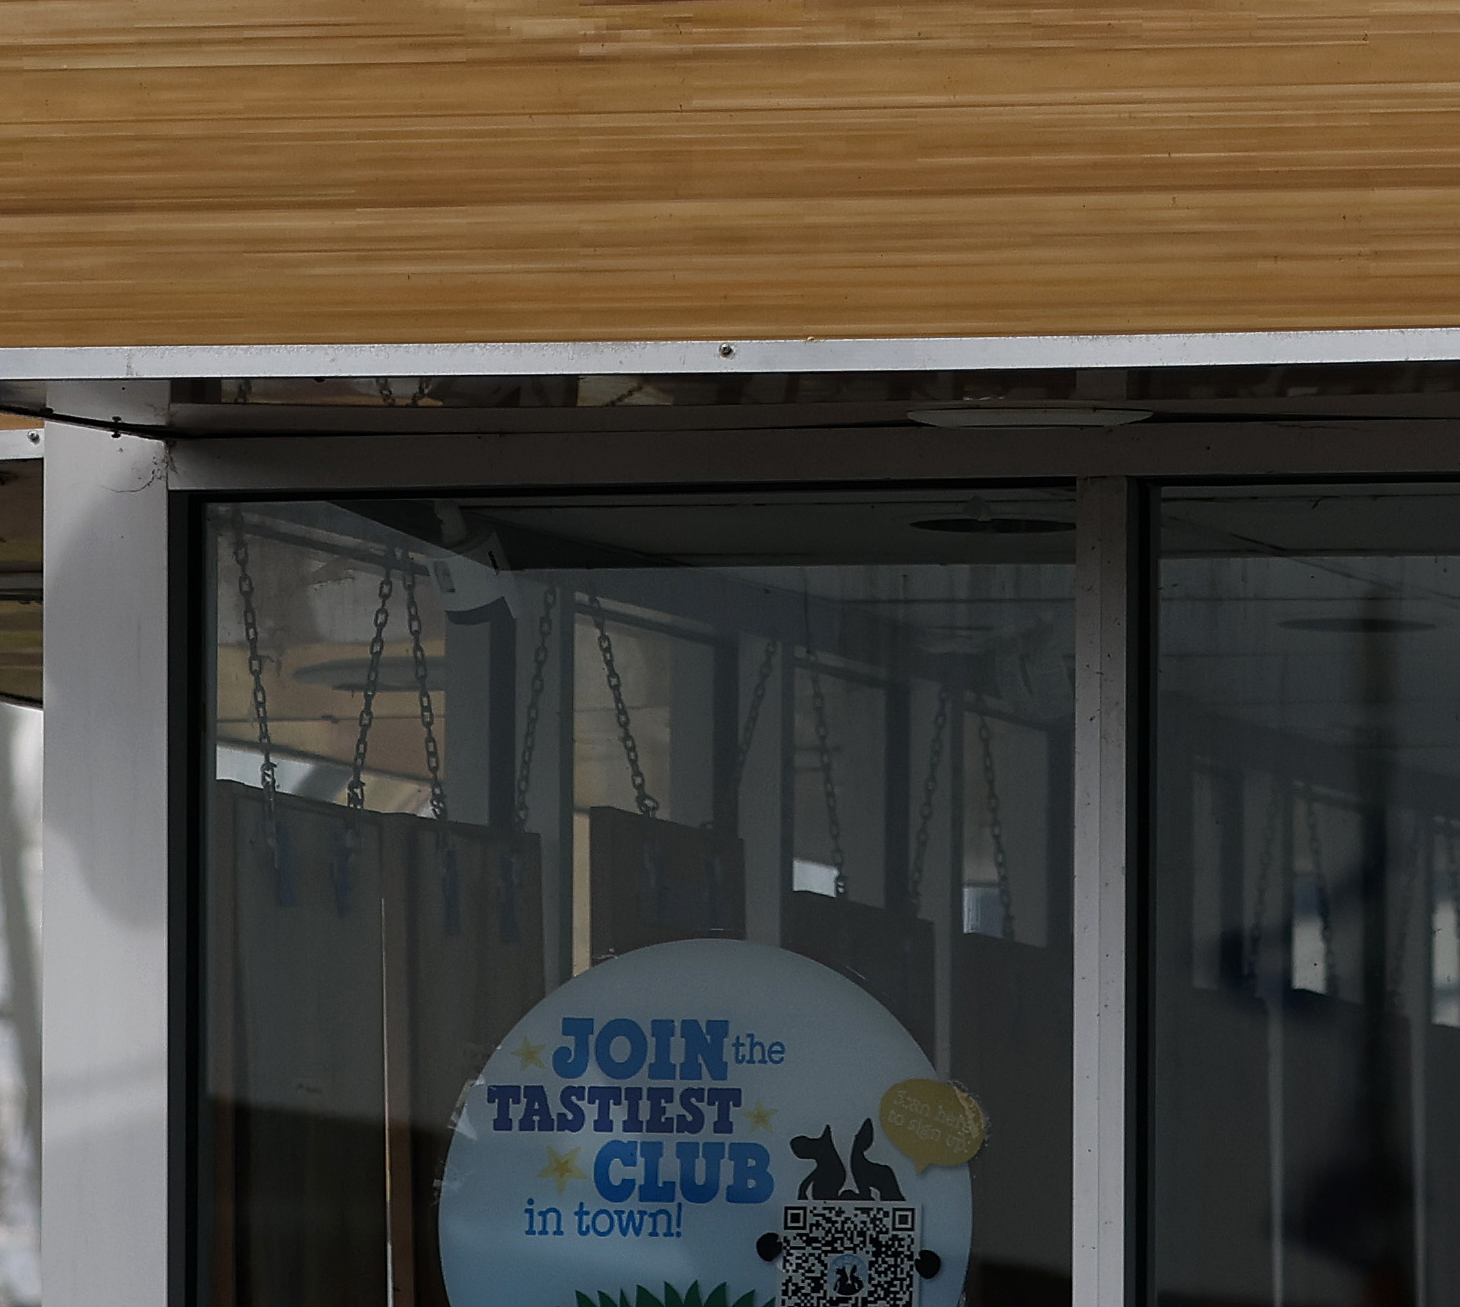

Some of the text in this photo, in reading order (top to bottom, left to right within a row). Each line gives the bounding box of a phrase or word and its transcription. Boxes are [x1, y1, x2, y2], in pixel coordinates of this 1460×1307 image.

[552, 1017, 786, 1081] JOIN the
[486, 1084, 742, 1134] TASTIEST
[593, 1140, 775, 1204] CLUB
[524, 1198, 683, 1238] in town!
